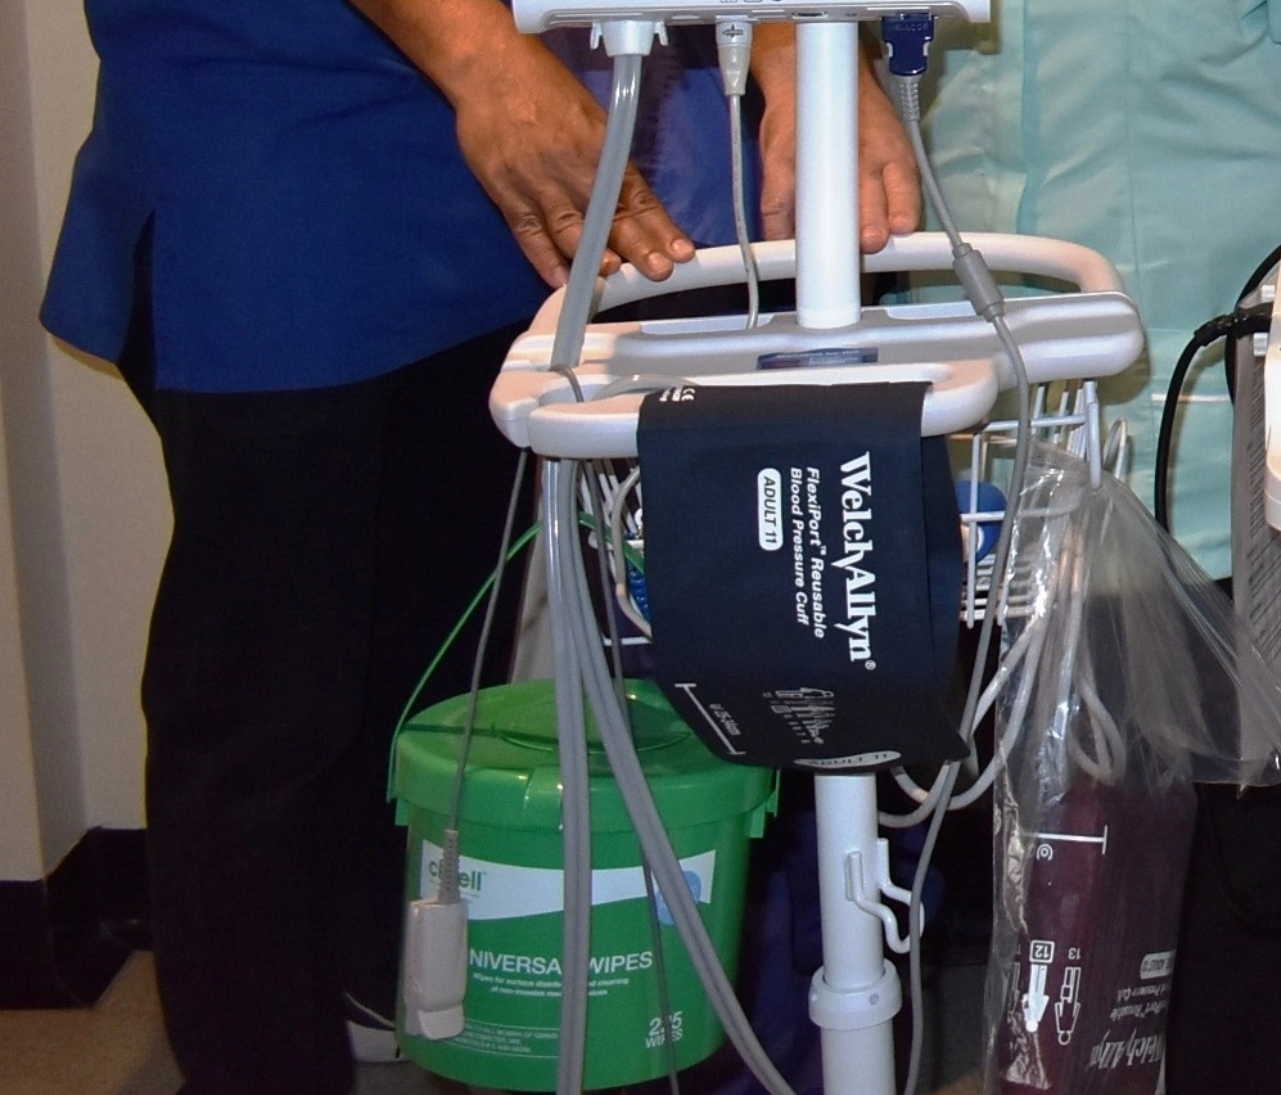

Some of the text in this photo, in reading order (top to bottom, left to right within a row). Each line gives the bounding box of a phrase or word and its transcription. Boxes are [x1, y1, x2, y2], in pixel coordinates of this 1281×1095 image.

[764, 476, 777, 546] ADULT 11
[789, 467, 809, 625] Blood Pressure Cuff
[811, 557, 825, 639] Reusable
[470, 949, 561, 975] NIVERSA
[1035, 945, 1050, 957] 12
[1068, 947, 1081, 960] 13
